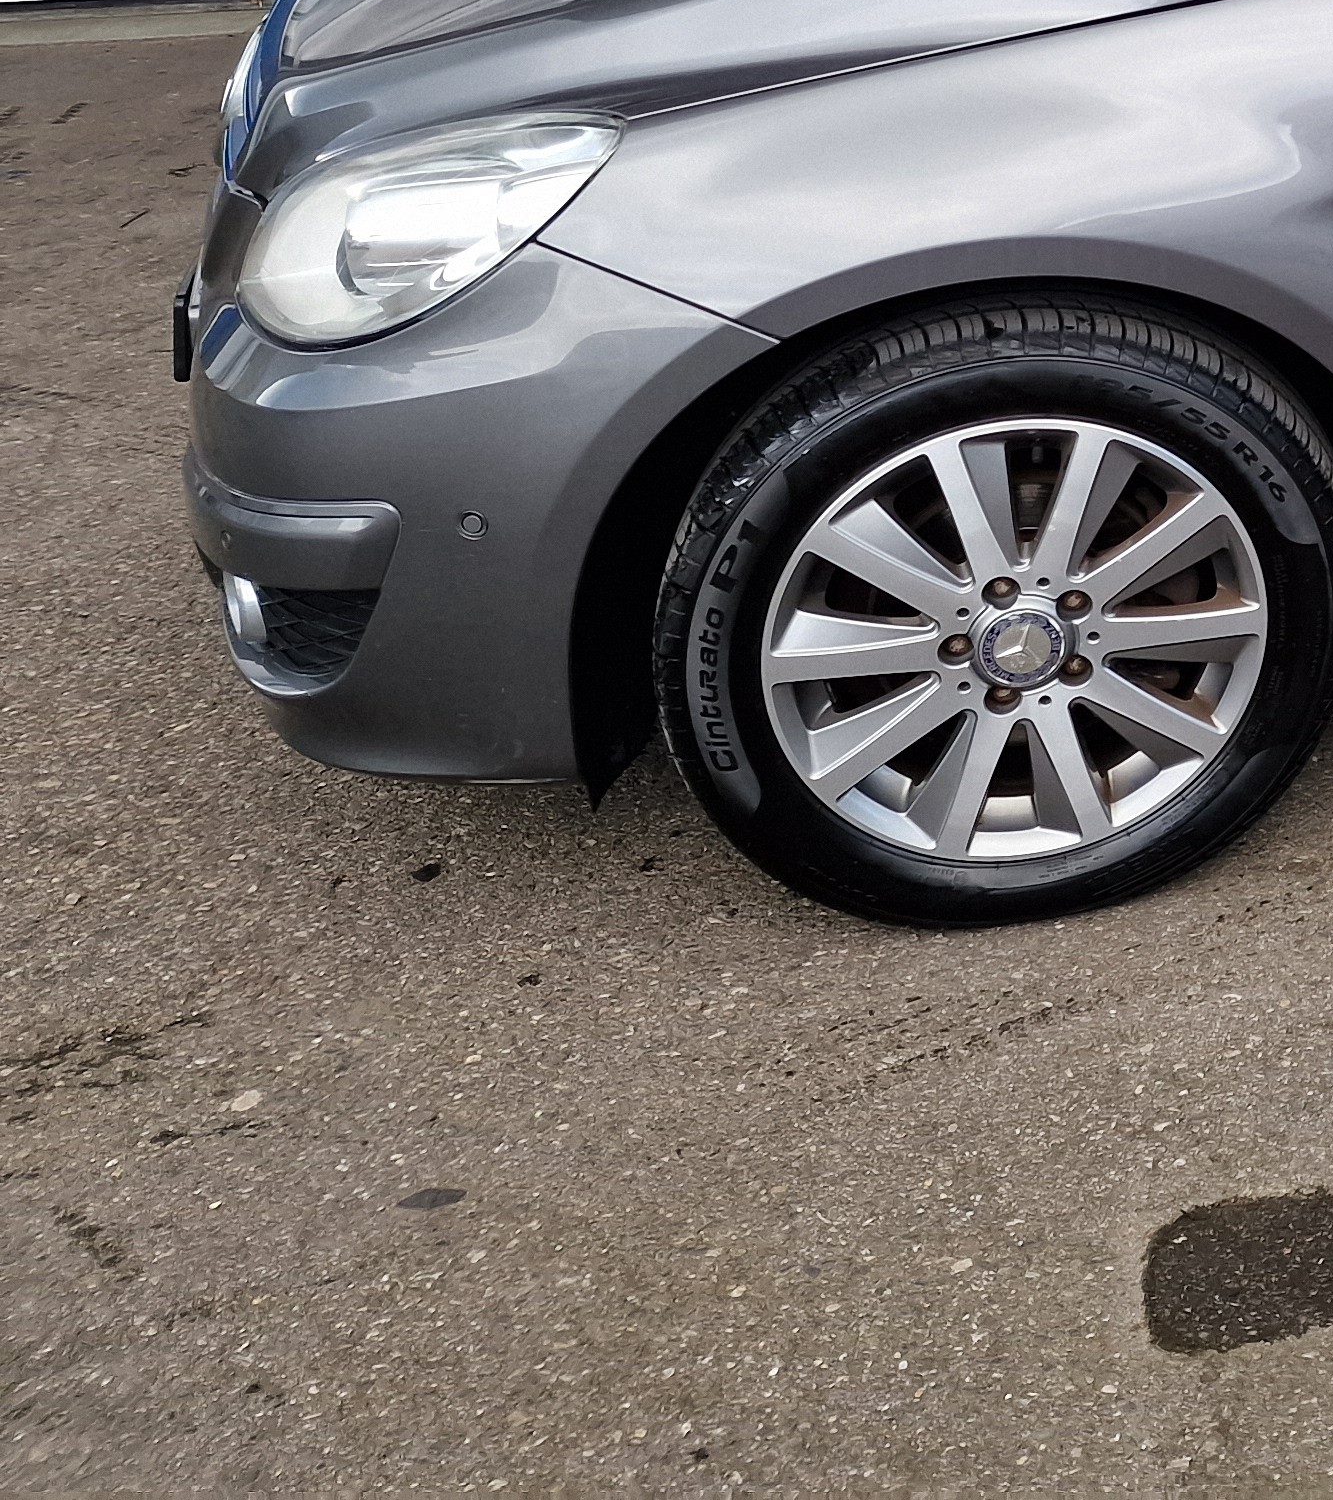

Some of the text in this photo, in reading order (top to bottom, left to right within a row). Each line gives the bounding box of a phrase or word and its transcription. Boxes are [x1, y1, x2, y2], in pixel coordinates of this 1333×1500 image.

[1232, 439, 1288, 503] R16
[698, 518, 761, 772] Cinturato P1
